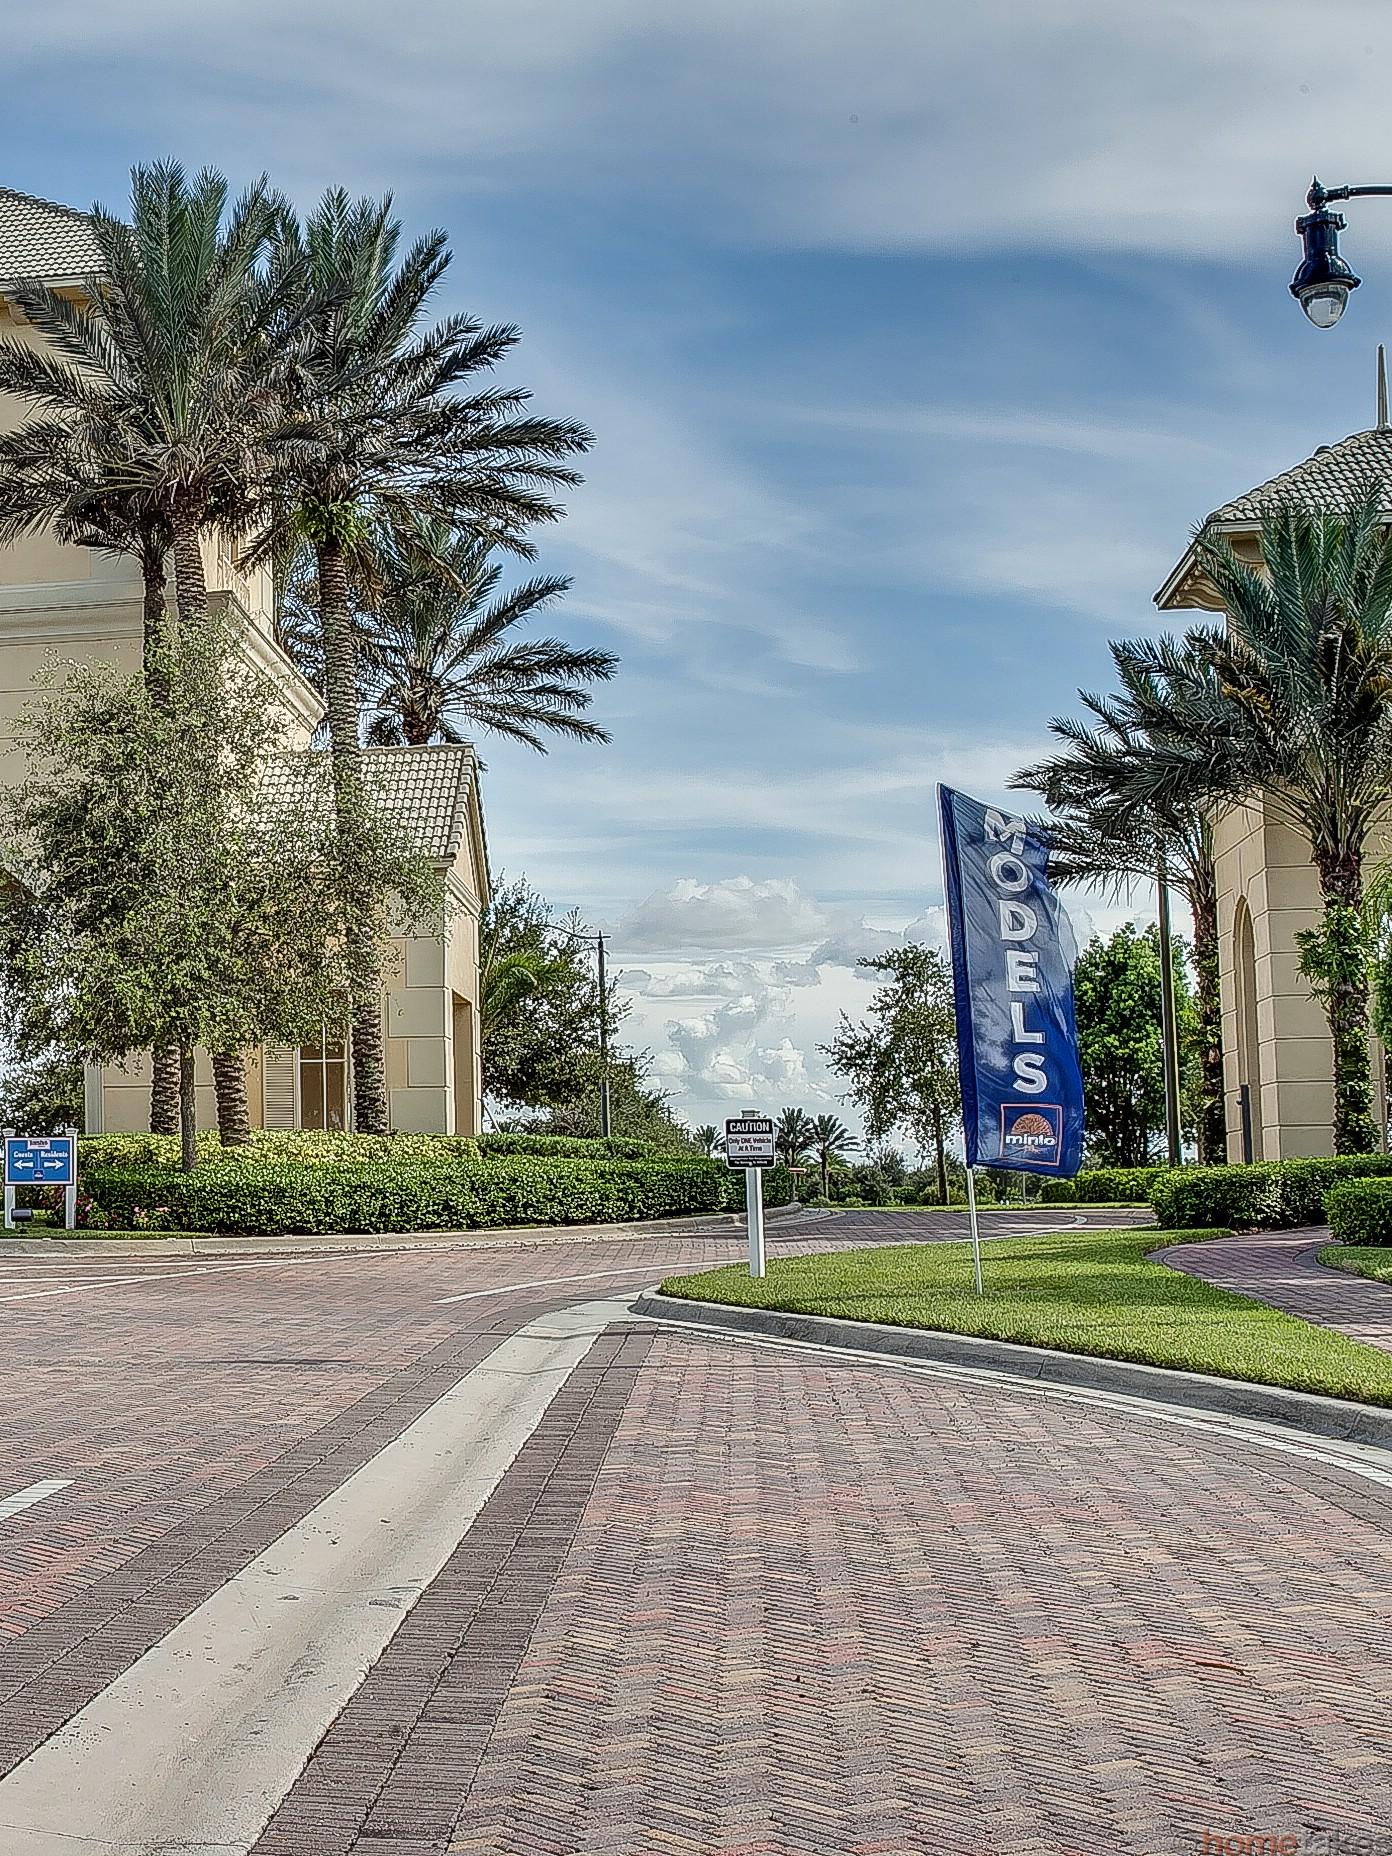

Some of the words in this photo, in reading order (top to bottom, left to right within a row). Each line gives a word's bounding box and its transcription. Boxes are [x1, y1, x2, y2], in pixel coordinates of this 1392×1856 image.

[984, 808, 1048, 1094] MODELS
[729, 1121, 770, 1132] CAUTION
[728, 1137, 739, 1145] Only
[1005, 1133, 1056, 1146] minto
[40, 1150, 68, 1158] Residents
